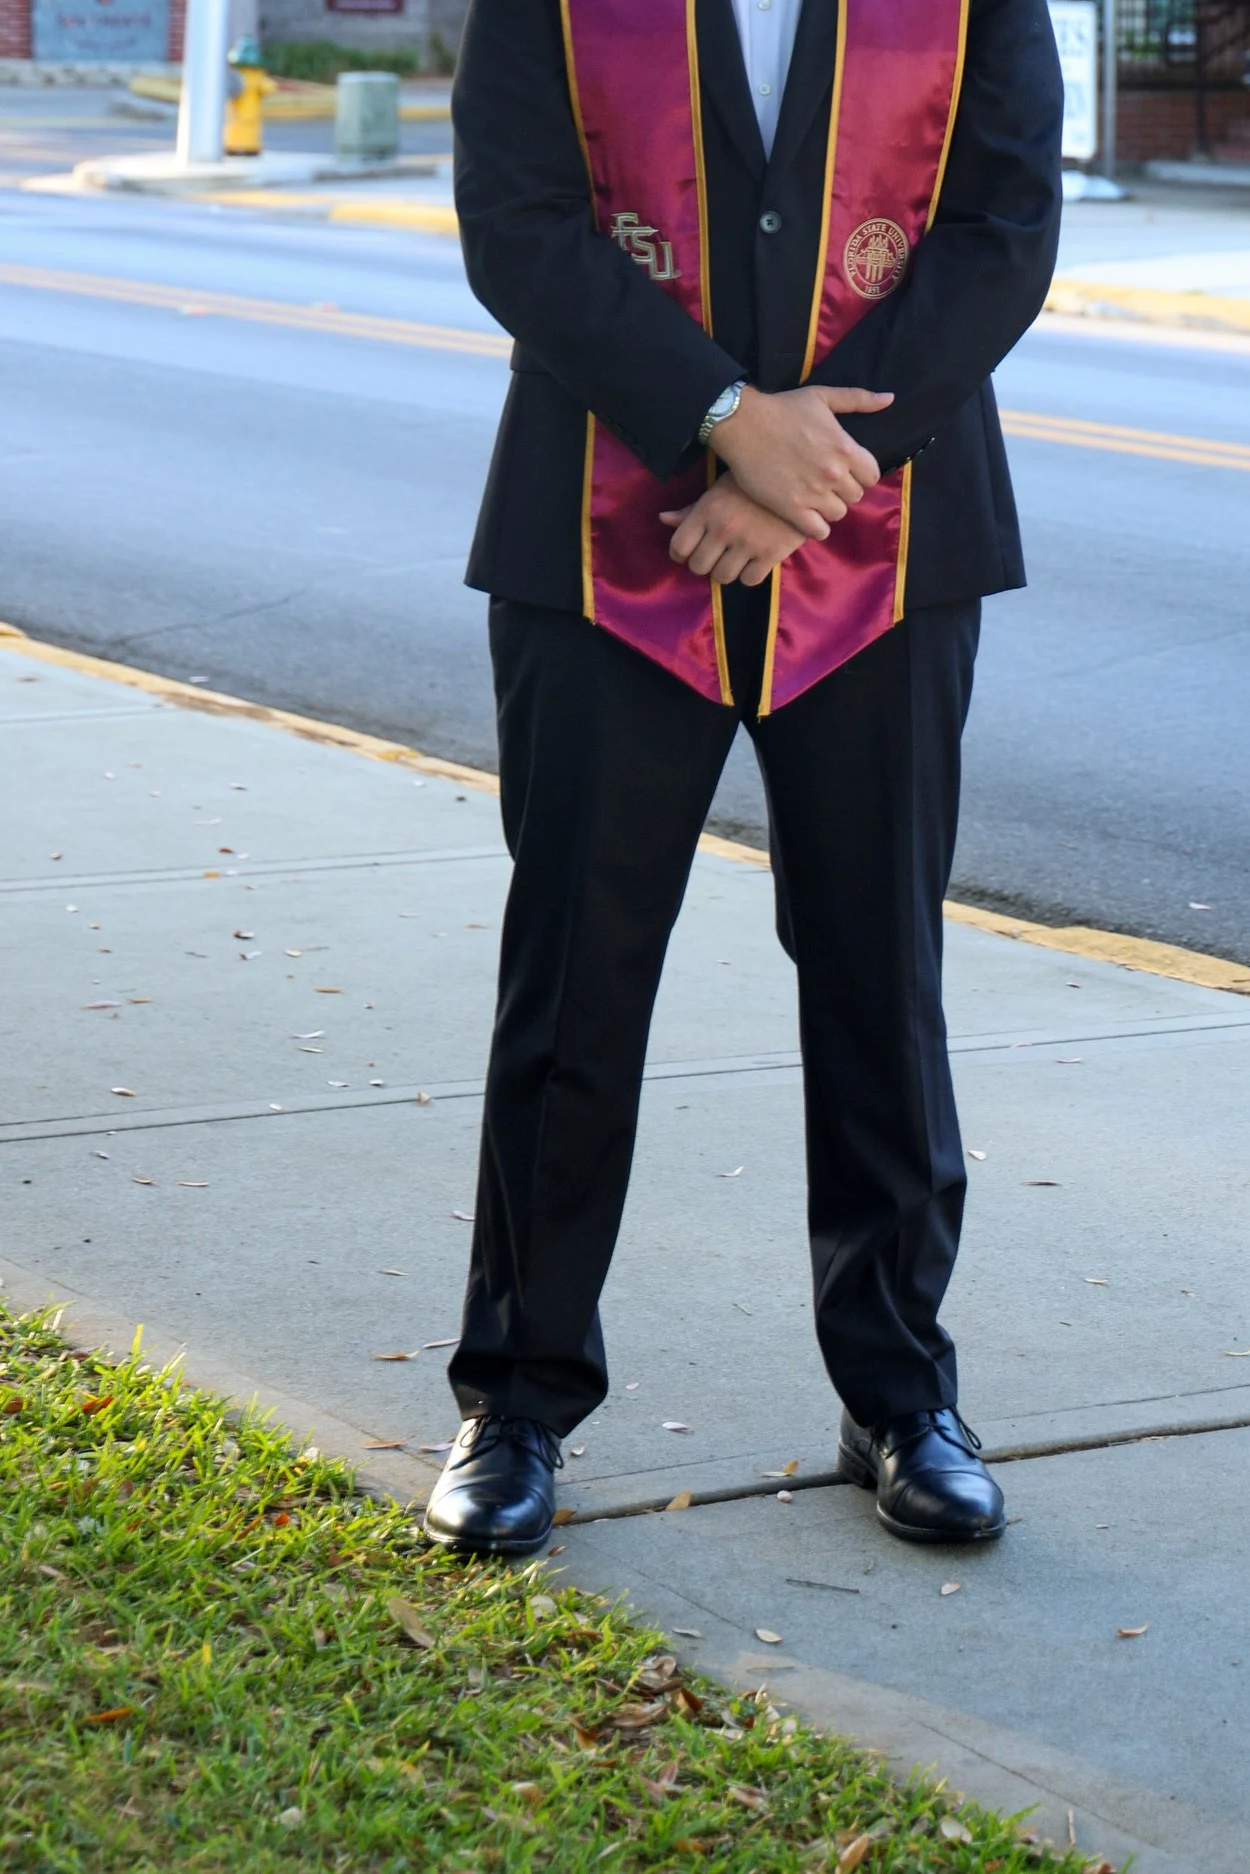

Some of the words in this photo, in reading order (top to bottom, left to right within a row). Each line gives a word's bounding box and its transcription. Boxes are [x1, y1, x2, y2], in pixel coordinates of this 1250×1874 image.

[609, 212, 674, 280] FSU
[846, 234, 864, 277] FLORIDA
[861, 222, 887, 236] STATE
[887, 227, 906, 280] UNIVERSITY
